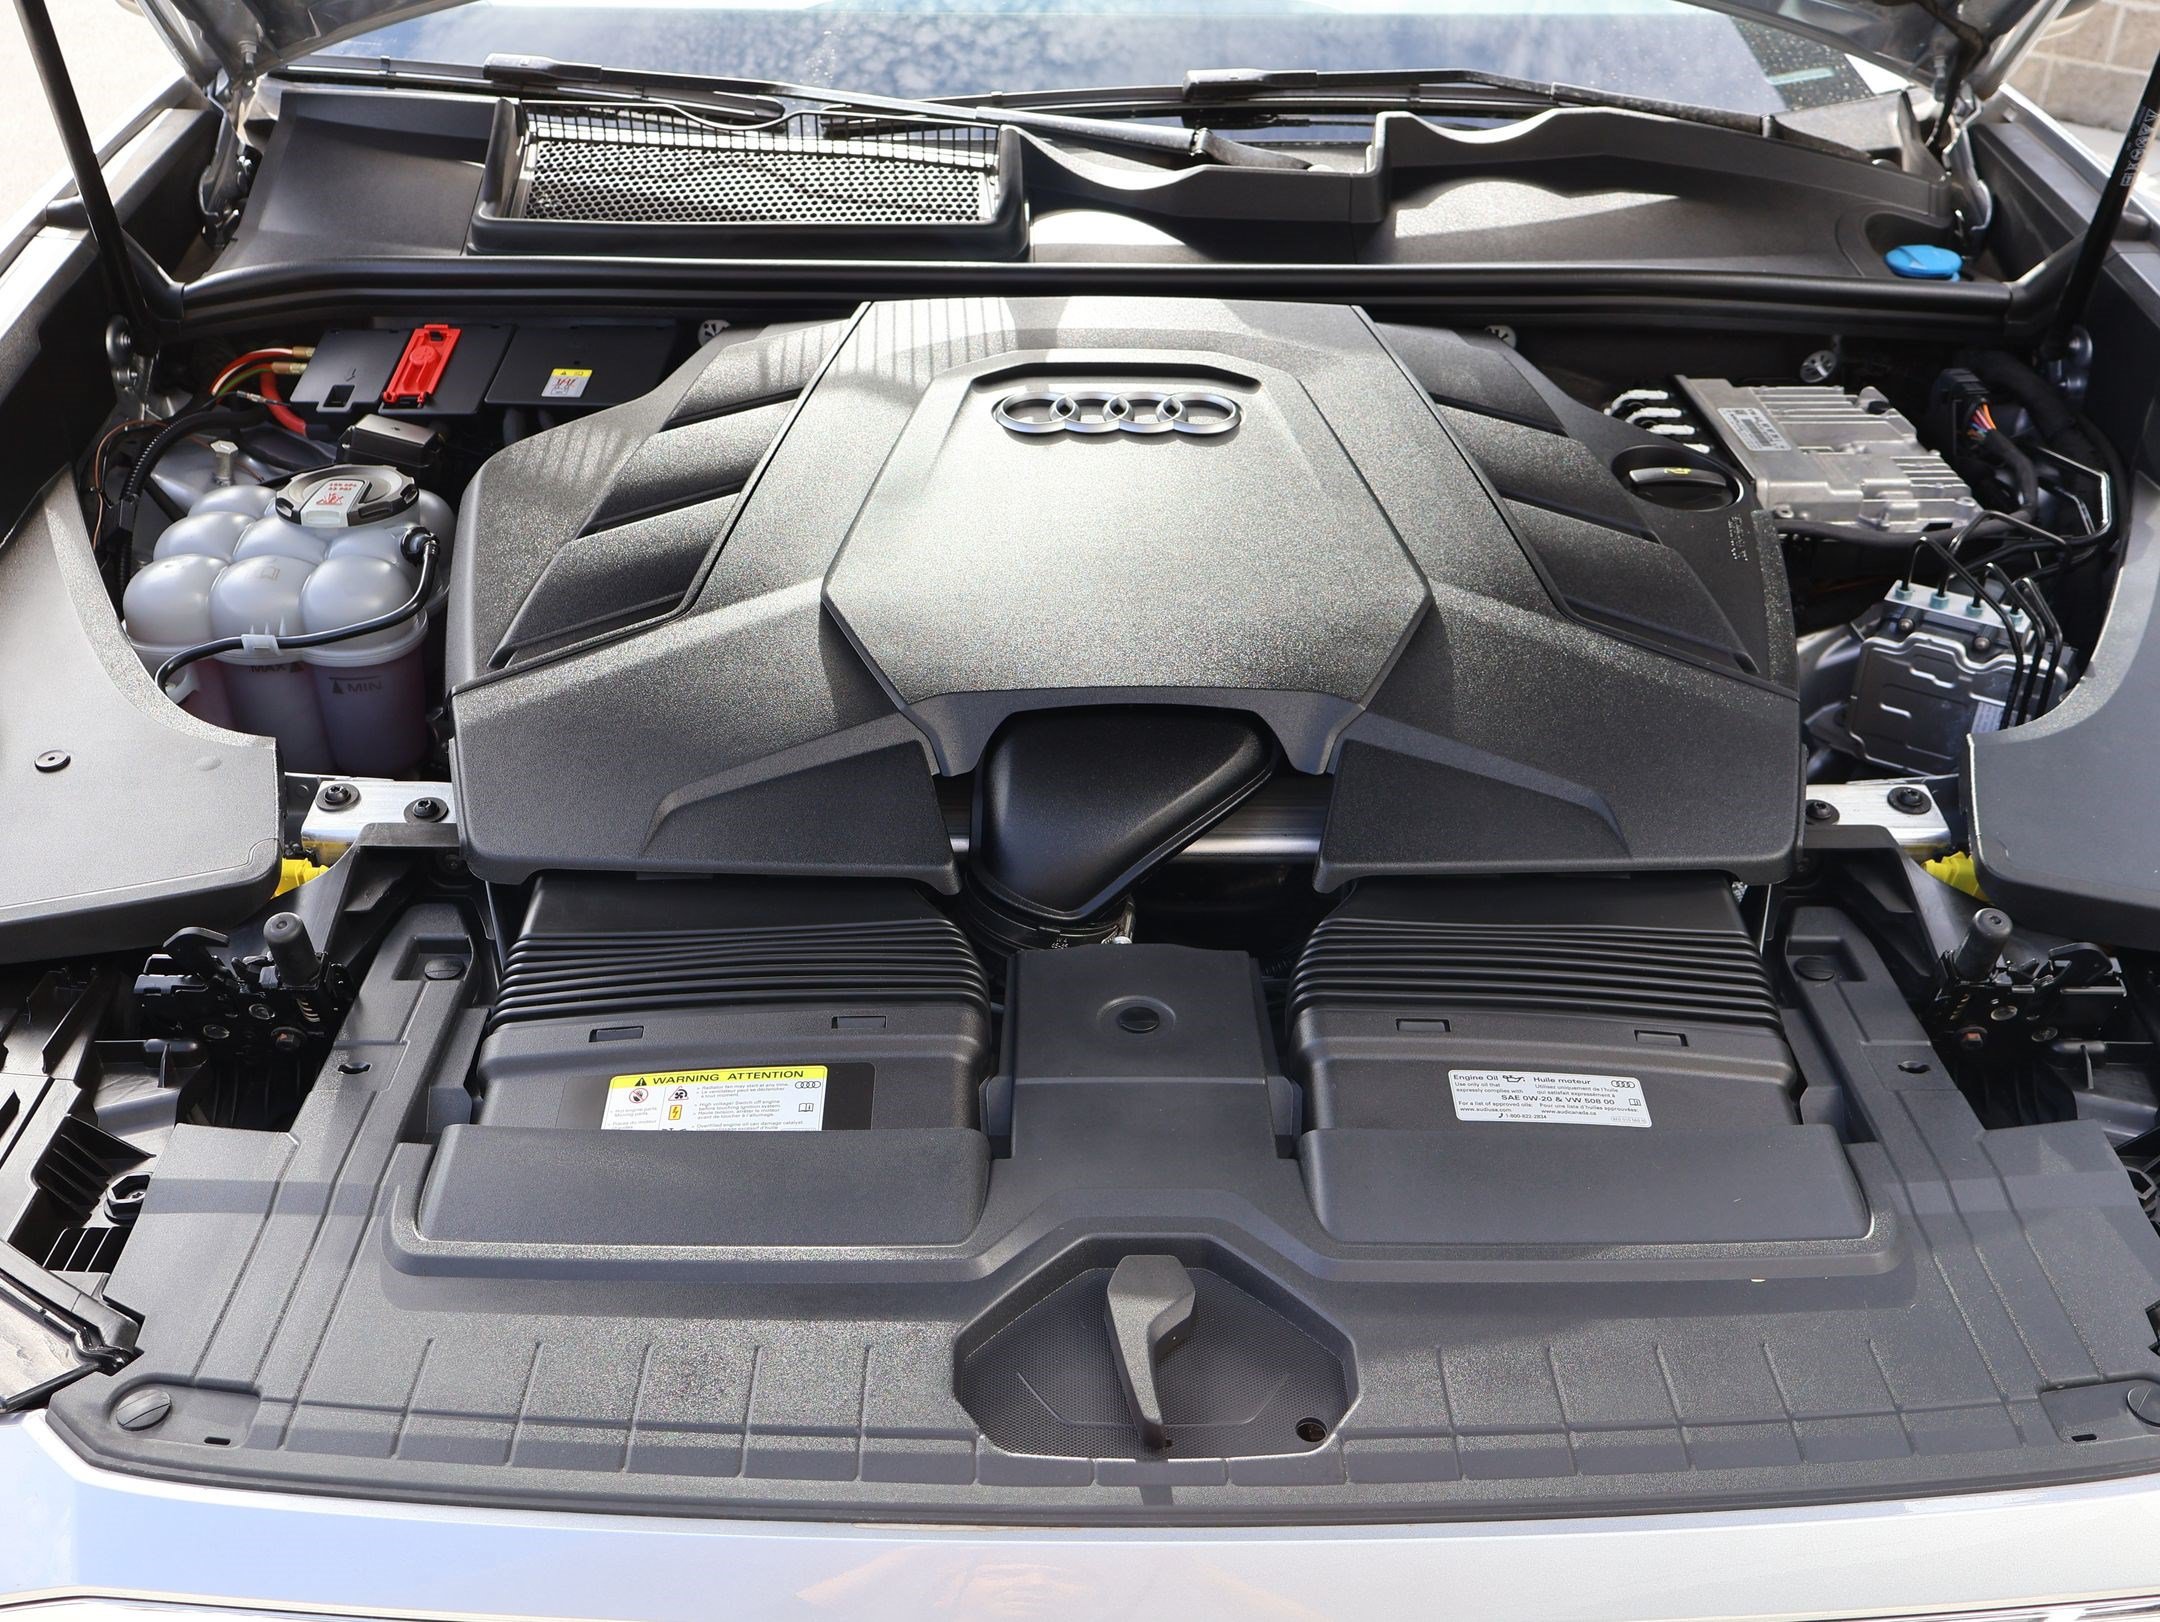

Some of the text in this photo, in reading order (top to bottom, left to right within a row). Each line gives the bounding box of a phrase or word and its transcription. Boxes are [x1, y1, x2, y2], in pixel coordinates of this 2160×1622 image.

[249, 663, 286, 673] MAX
[347, 680, 382, 693] MIN
[652, 1070, 804, 1084] WARNING ATTENTION
